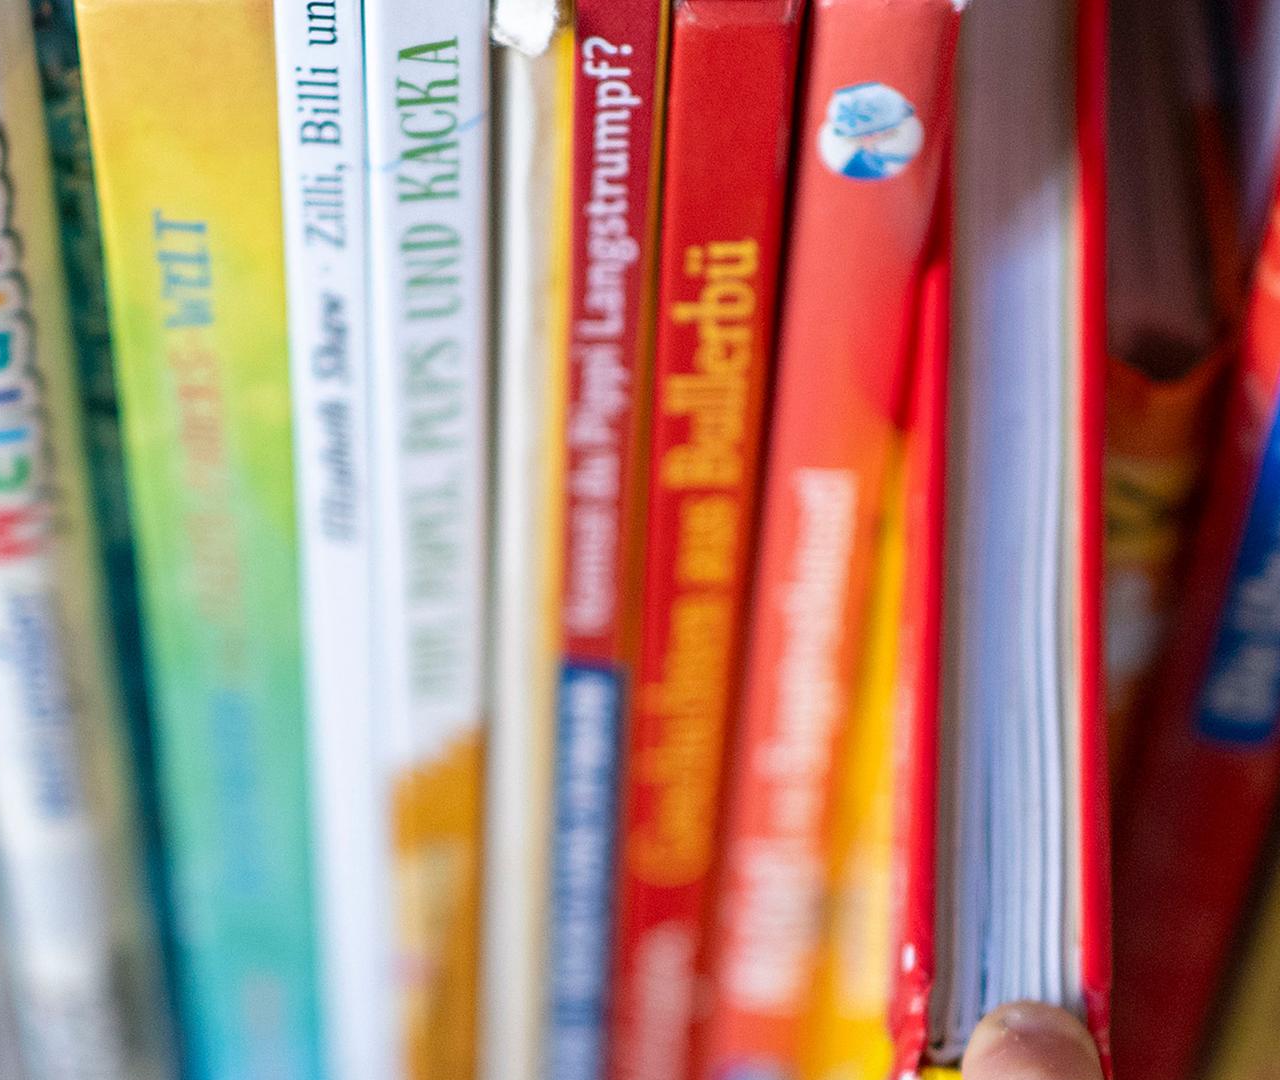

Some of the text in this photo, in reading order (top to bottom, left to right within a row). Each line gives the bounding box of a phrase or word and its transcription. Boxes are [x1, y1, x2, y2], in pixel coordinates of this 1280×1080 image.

[295, 66, 342, 148] Billi
[395, 36, 461, 206] KACKA
[300, 162, 351, 250] Zilli,
[580, 35, 642, 342] Langstrumpf?
[400, 222, 463, 325] UND
[311, 294, 347, 386] Shaw
[662, 236, 762, 491] Bullerbü
